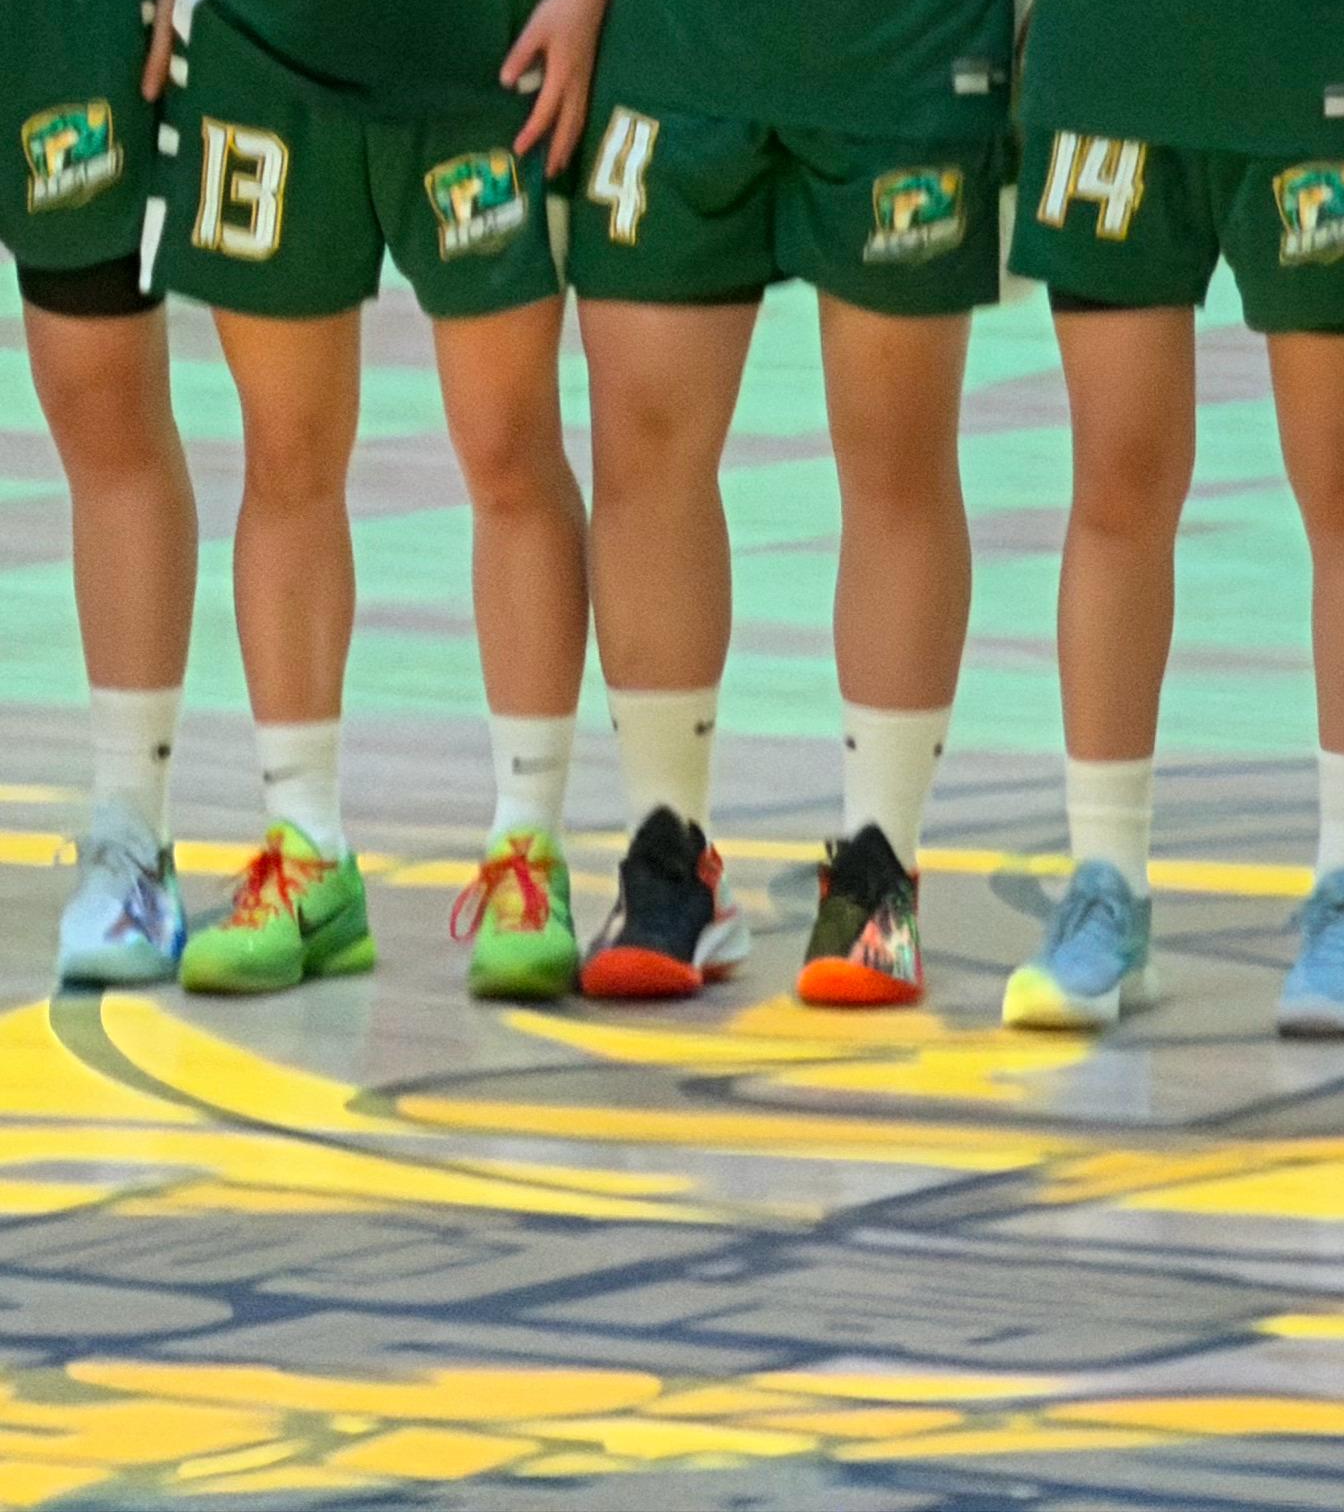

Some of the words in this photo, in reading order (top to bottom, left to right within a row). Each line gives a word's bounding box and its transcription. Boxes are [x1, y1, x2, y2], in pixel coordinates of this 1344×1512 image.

[192, 115, 289, 261] 13
[586, 104, 660, 246] 4
[1036, 129, 1148, 242] 14
